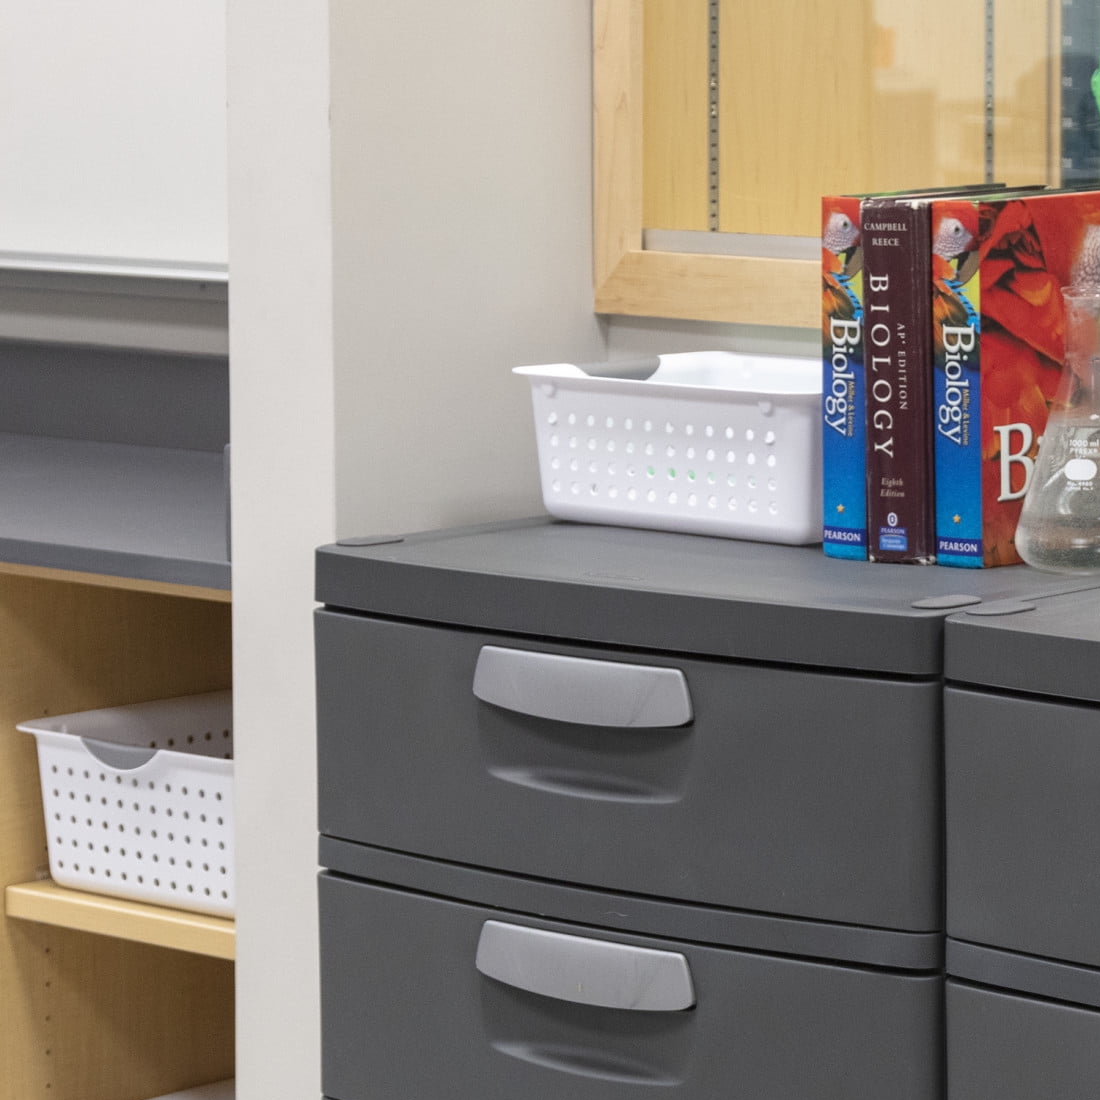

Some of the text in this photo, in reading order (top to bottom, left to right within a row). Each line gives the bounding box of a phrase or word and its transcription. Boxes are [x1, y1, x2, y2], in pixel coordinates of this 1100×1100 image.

[863, 222, 908, 232] CAMPBELL
[871, 237, 901, 247] REECE
[869, 272, 894, 459] BIOLOGY
[824, 316, 861, 436] Biology
[897, 351, 909, 410] EDITION
[937, 322, 976, 446] Biology
[879, 488, 905, 498] Edition
[823, 529, 862, 542] PEARSON
[880, 527, 905, 535] PEARSON
[938, 540, 978, 553] PEARSON
